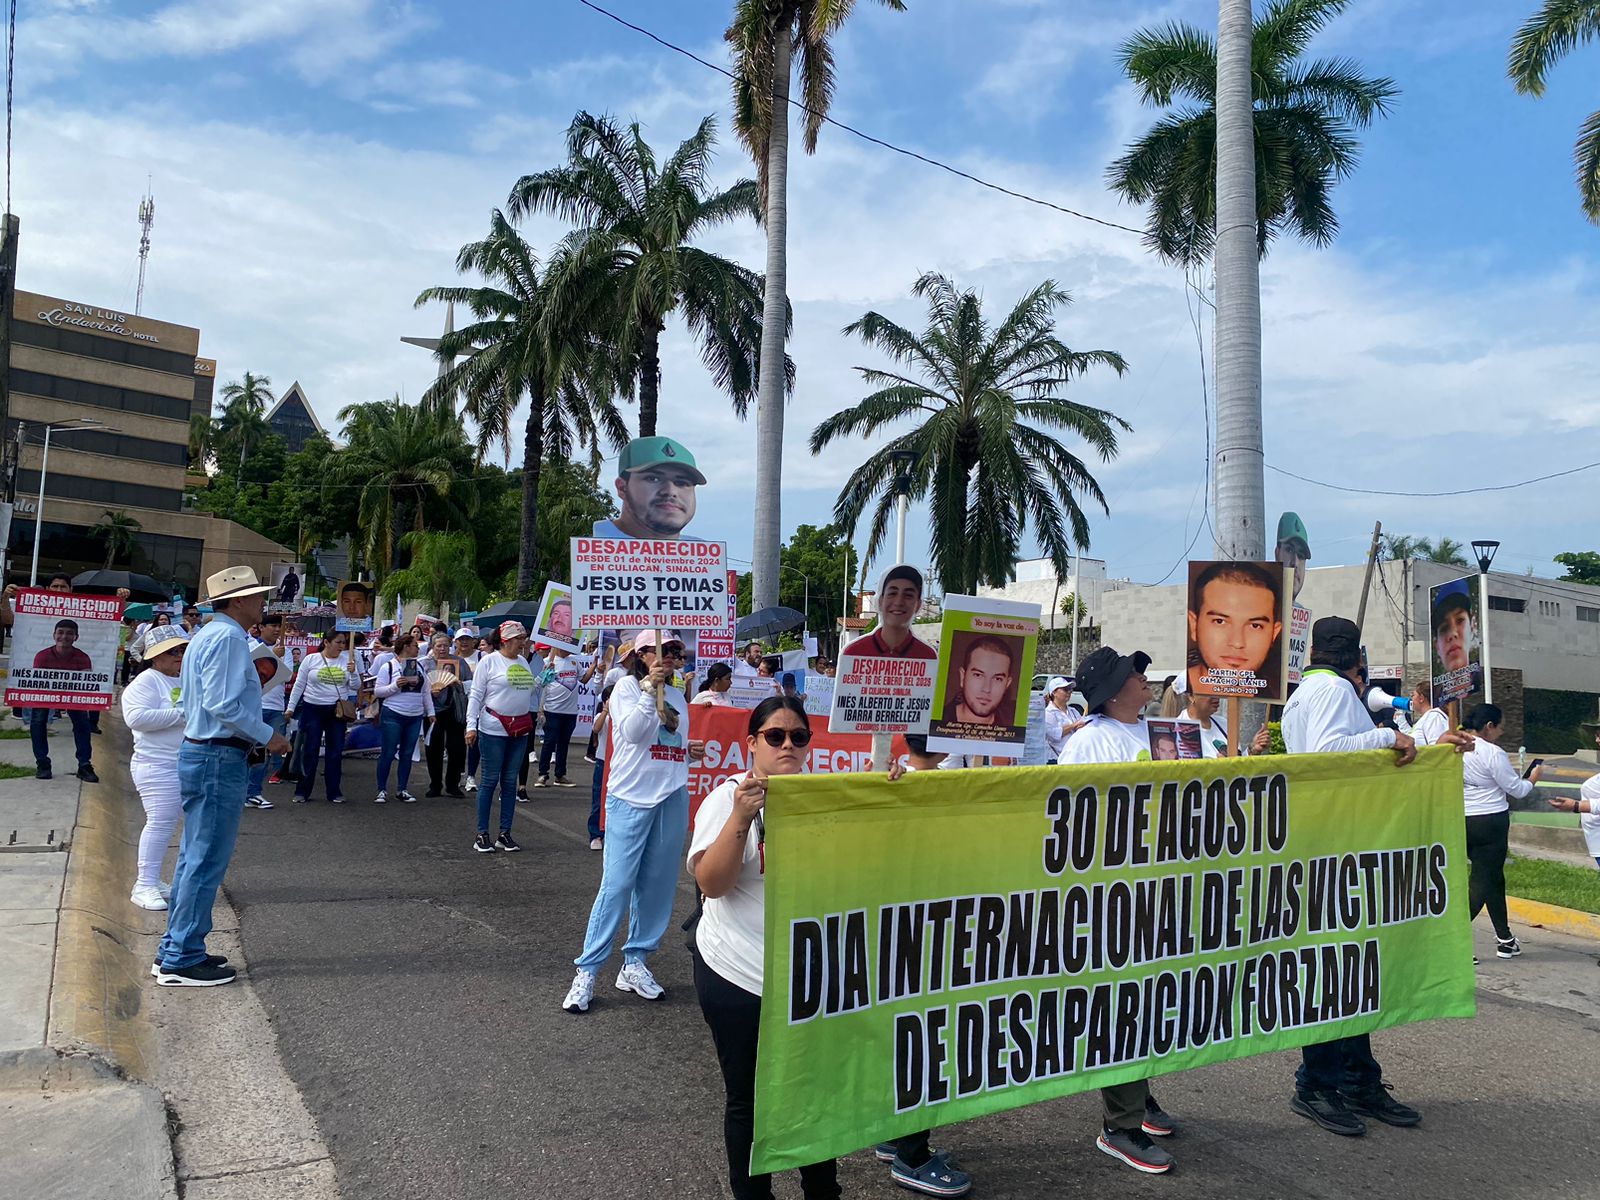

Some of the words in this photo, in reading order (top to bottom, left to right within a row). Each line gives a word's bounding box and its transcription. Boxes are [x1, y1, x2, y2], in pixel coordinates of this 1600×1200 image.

[64, 303, 93, 316] SAN
[97, 310, 126, 324] LUIS
[37, 308, 133, 337] Lindavista
[133, 332, 160, 344] HOTEL
[577, 539, 721, 557] DESAPARECIDO
[576, 555, 611, 563] DESDE
[613, 555, 625, 563] 01
[628, 555, 641, 564] de
[644, 556, 695, 565] Noviembre
[697, 557, 721, 566] 2024
[590, 563, 603, 571] EN
[665, 566, 708, 574] SINALOA
[576, 575, 647, 591] JESUS
[653, 576, 724, 593] TOMAS
[20, 593, 120, 614] ¡DESAPARECIDO!
[588, 595, 650, 610] FELIX
[656, 596, 715, 611] FELIX
[23, 605, 44, 614] DESDE
[63, 609, 84, 617] ENERO
[85, 611, 97, 619] DEL
[578, 614, 650, 628] ¡ESPERAMOS
[653, 615, 667, 626] TU
[670, 615, 723, 627] REGRESO!
[975, 618, 982, 627] Yo
[702, 644, 717, 656] 115
[719, 646, 730, 655] KG
[852, 659, 926, 677] DESAPARECIDO
[1208, 669, 1238, 677] MARTIN
[32, 670, 70, 681] ALBERTO
[71, 672, 82, 681] DE
[842, 674, 863, 685] DESDE
[873, 676, 882, 686] DE
[904, 678, 914, 687] DEL
[1199, 677, 1238, 687] CAMACHO
[1239, 679, 1267, 688] LLANES
[18, 679, 50, 690] IBARRA
[51, 681, 100, 692] BERRELLEZA
[20, 693, 60, 703] QUEREMOS
[62, 695, 71, 703] DE
[837, 693, 857, 709] INÉS
[858, 696, 893, 710] ALBERTO
[895, 698, 905, 710] DE
[906, 695, 931, 711] JESÚS
[843, 709, 873, 722] IBARRA
[875, 710, 921, 723] BERRELLEZA
[1043, 784, 1098, 877] 30
[1102, 781, 1153, 870] DE
[1154, 772, 1288, 866] AGOSTO
[788, 907, 871, 1026] DIA
[876, 873, 1195, 1006] INTERNACIONAL
[1199, 866, 1245, 952] DE
[1246, 858, 1304, 949] LAS
[1304, 842, 1447, 934] VICTIMAS
[893, 1003, 949, 1115] DE
[954, 959, 1239, 1100] DESAPARICION
[1239, 936, 1381, 1037] FORZADA
